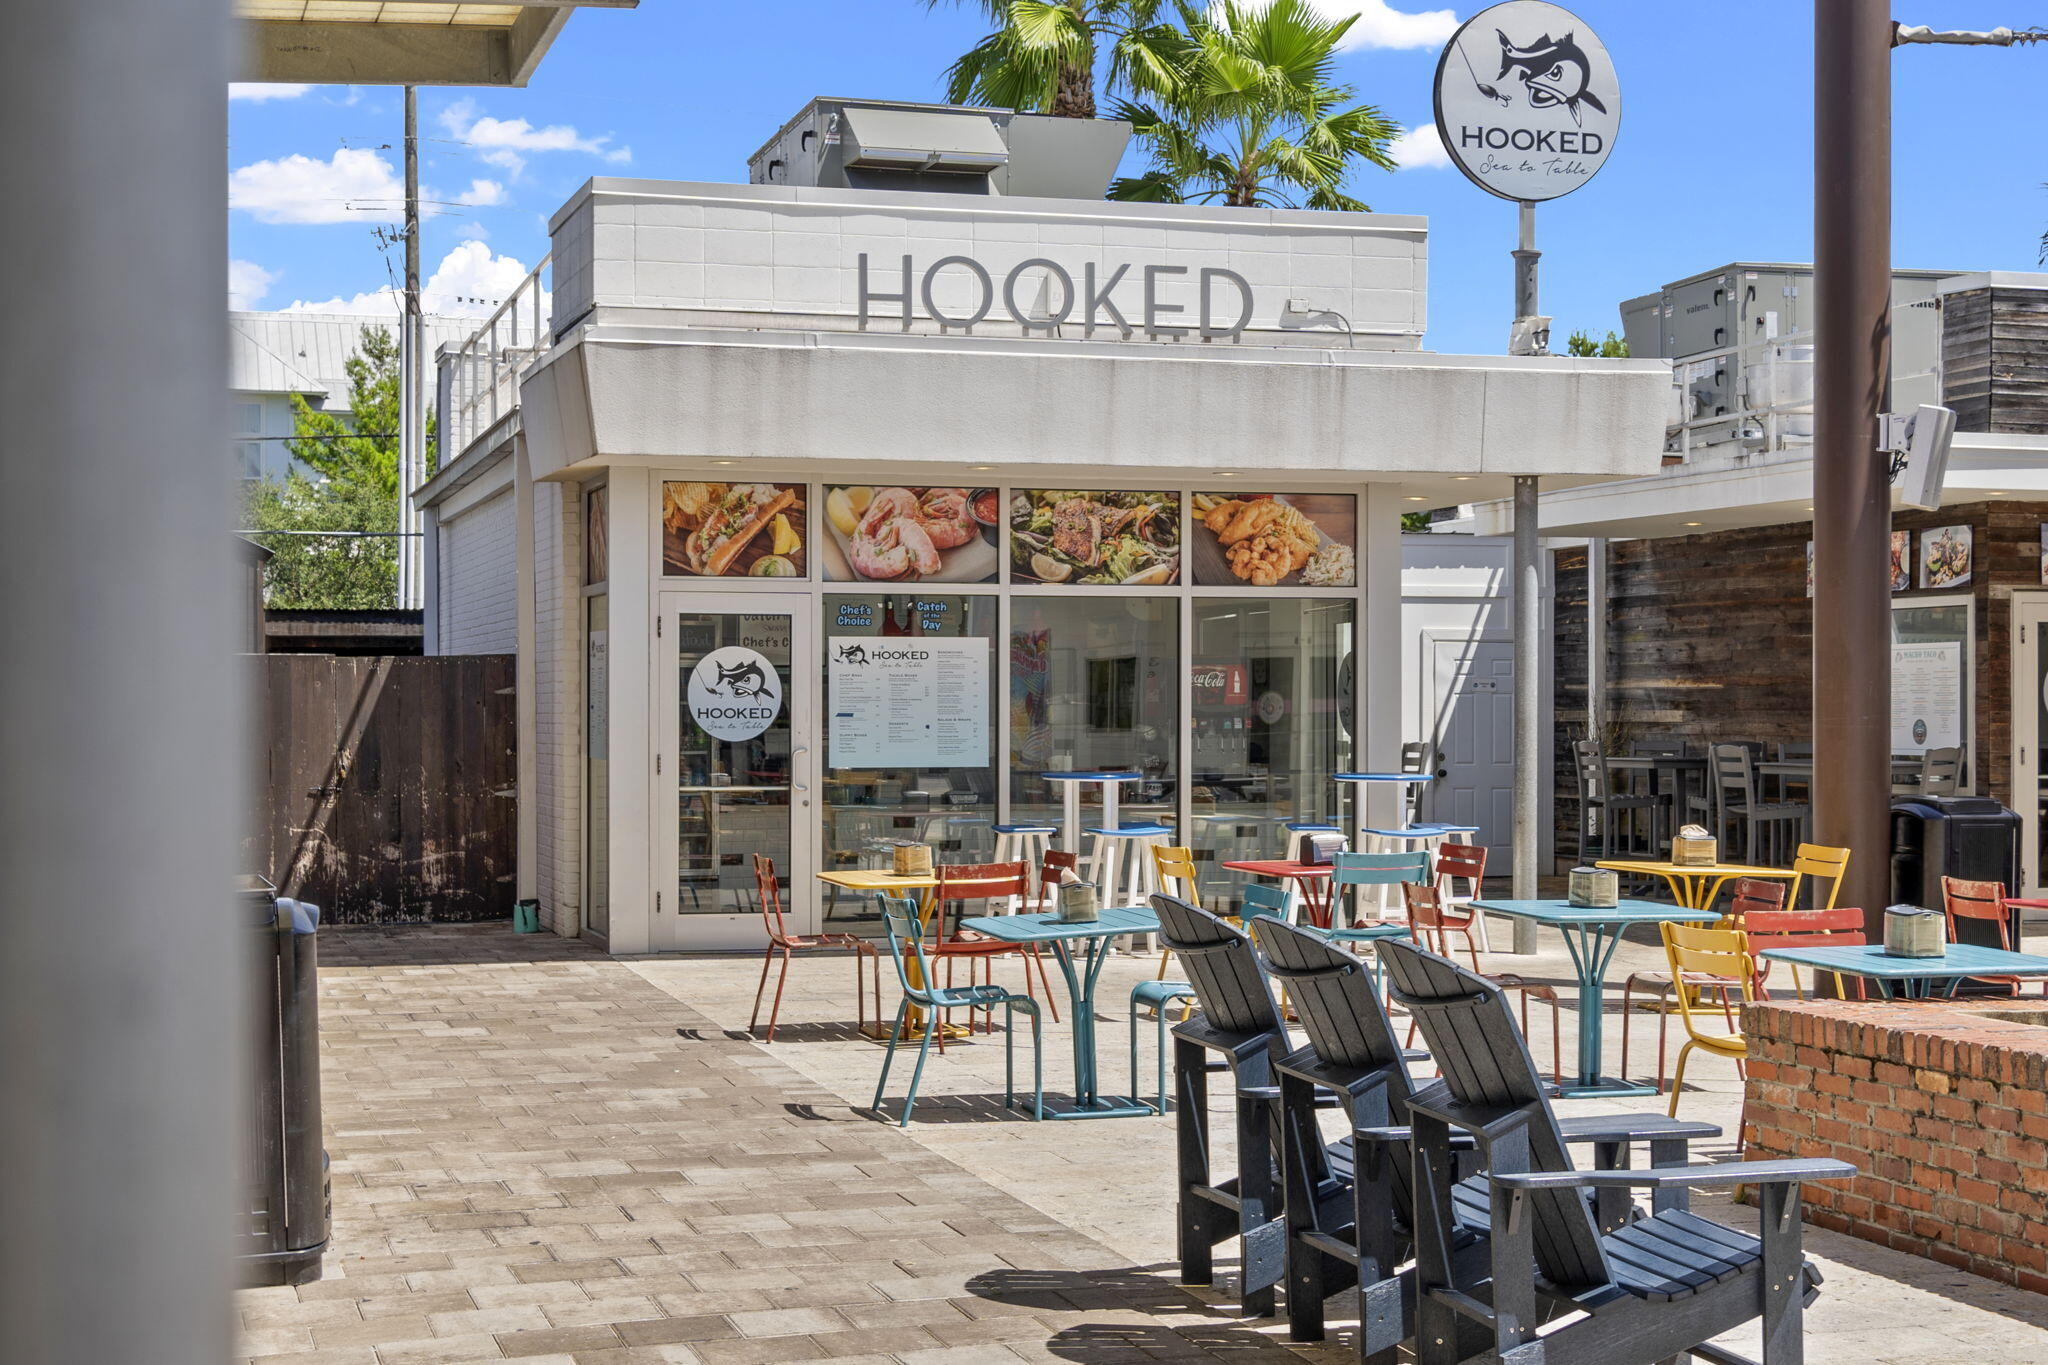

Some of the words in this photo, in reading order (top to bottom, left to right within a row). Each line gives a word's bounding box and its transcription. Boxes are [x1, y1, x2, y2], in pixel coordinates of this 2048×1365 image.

[1461, 125, 1603, 155] HOOKED
[1479, 153, 1512, 174] Sea
[1518, 160, 1535, 173] to
[1543, 157, 1589, 176] Table
[858, 252, 1254, 339] HOOKED
[840, 604, 873, 615] Chef's
[917, 601, 947, 611] Catch
[837, 615, 873, 626] Choice
[922, 620, 942, 631] Day
[743, 636, 779, 647] Chef's
[871, 650, 929, 660] HOOKED
[697, 707, 773, 719] HOOKED
